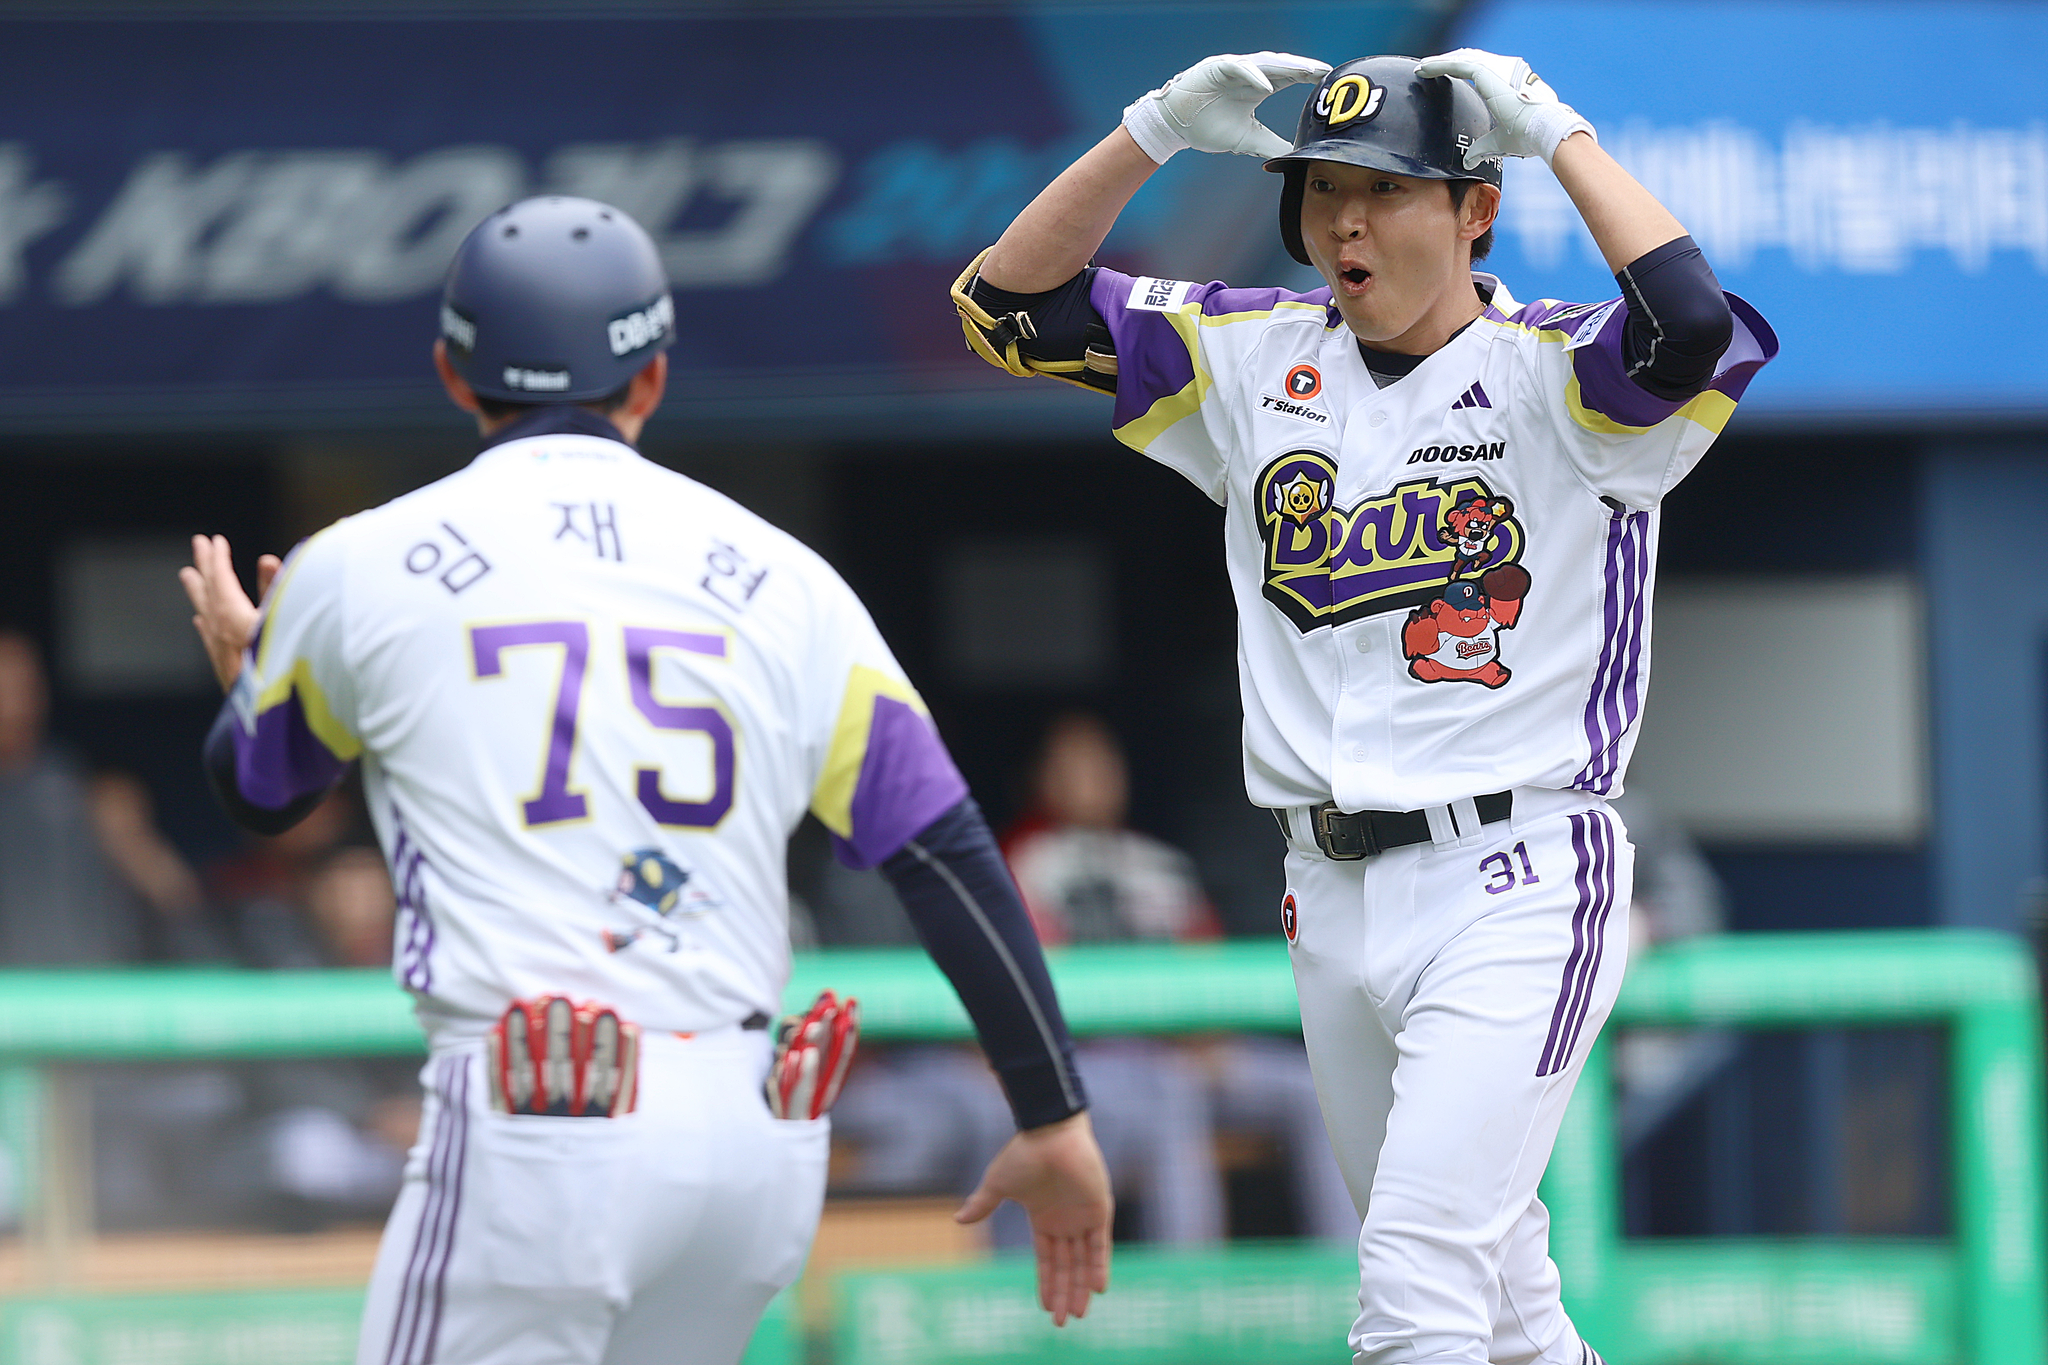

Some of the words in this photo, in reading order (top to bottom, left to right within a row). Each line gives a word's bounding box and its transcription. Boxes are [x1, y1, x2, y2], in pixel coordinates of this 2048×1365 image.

[1296, 373, 1313, 392] T
[1406, 442, 1505, 465] DOOSAN
[1456, 641, 1492, 659] Bears
[463, 616, 744, 834] 75
[1479, 840, 1540, 895] 31
